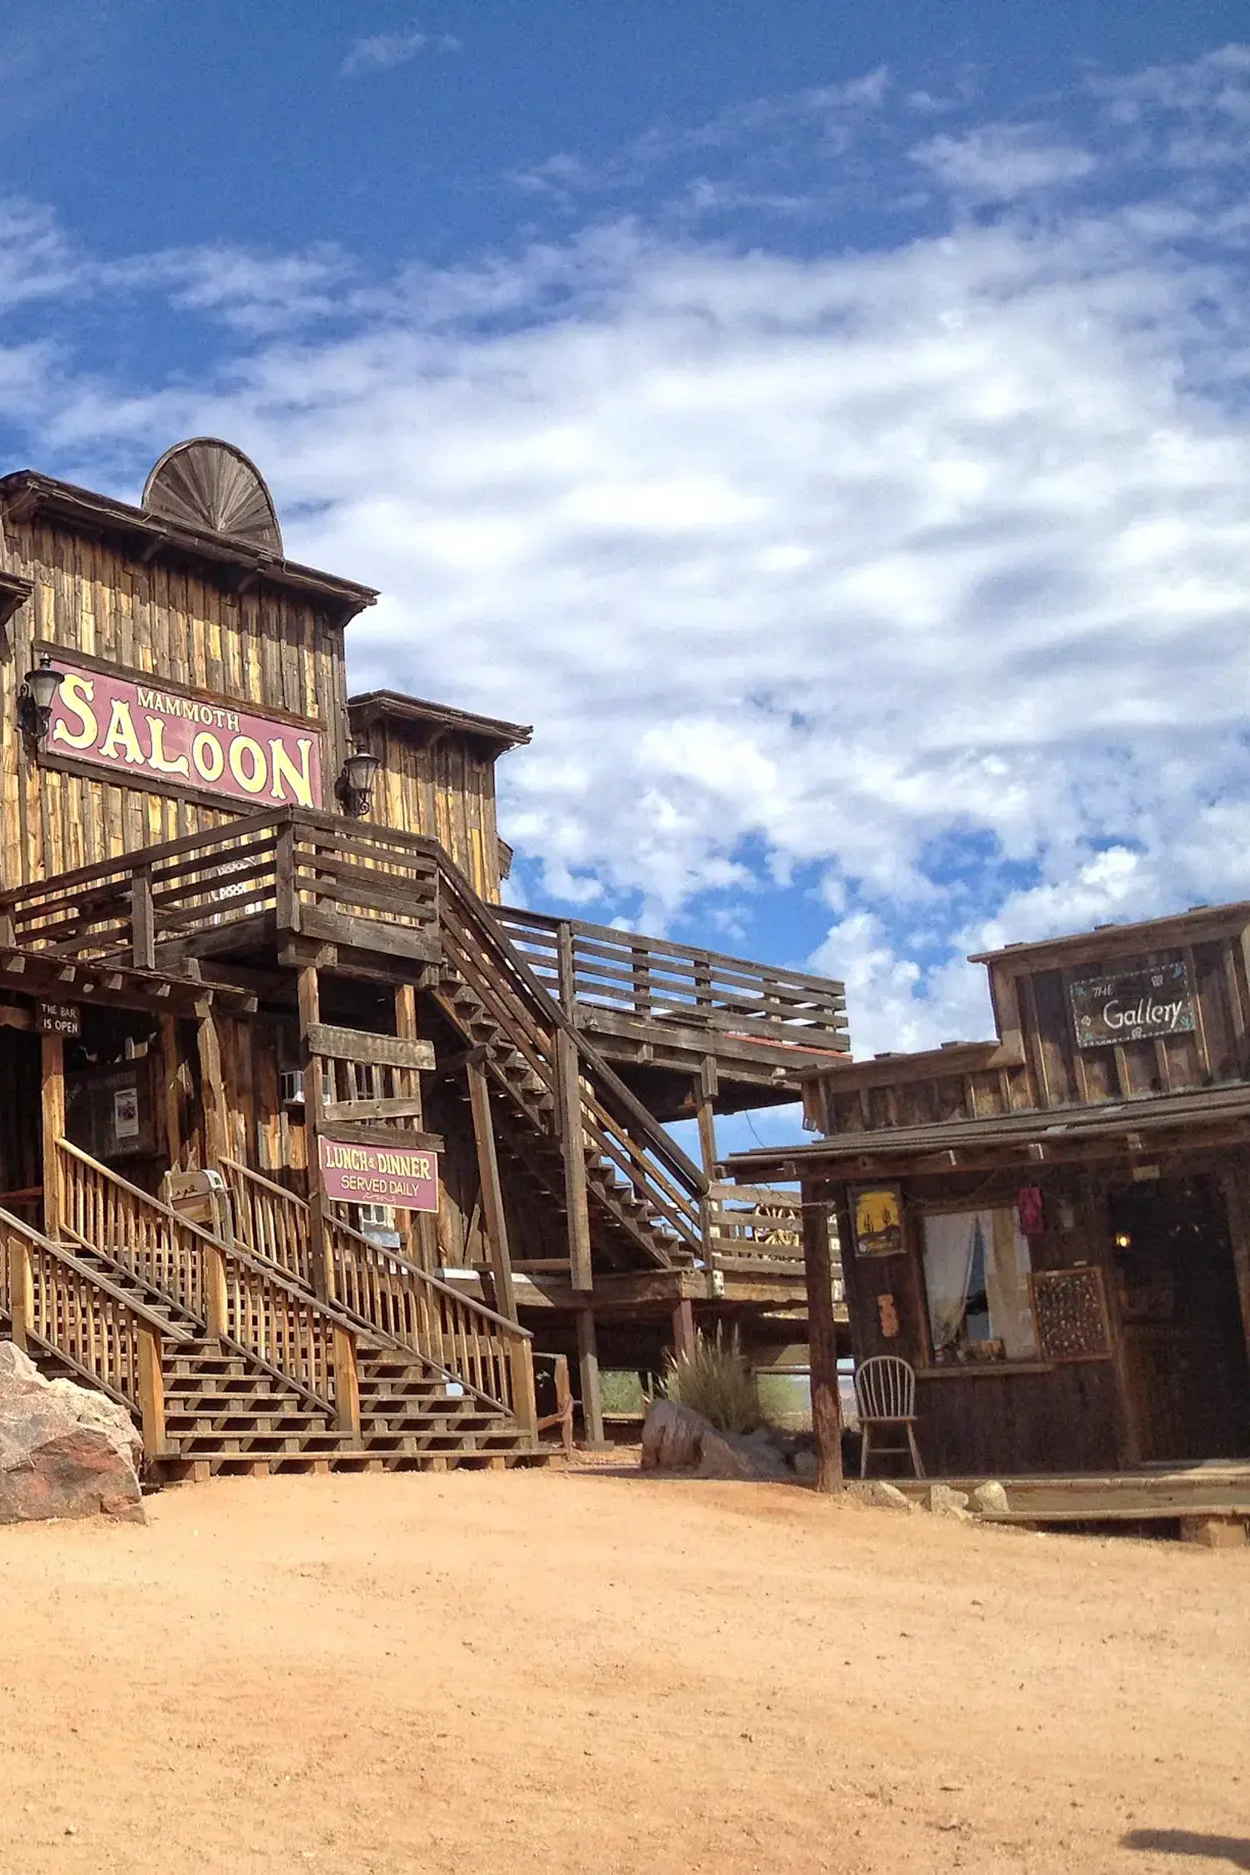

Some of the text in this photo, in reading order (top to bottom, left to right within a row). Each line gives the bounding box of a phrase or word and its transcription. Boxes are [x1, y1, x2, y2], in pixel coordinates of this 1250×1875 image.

[136, 686, 240, 732] MAMMOTH
[53, 673, 313, 808] SALOON
[1092, 984, 1114, 998] THE
[41, 1003, 76, 1018] THE BAR
[1103, 997, 1182, 1029] Gallery
[43, 1019, 78, 1034] IS OPEN
[325, 1146, 369, 1172] LUNCH
[376, 1153, 432, 1180] DINNER
[341, 1175, 420, 1197] SERVED DAILY
